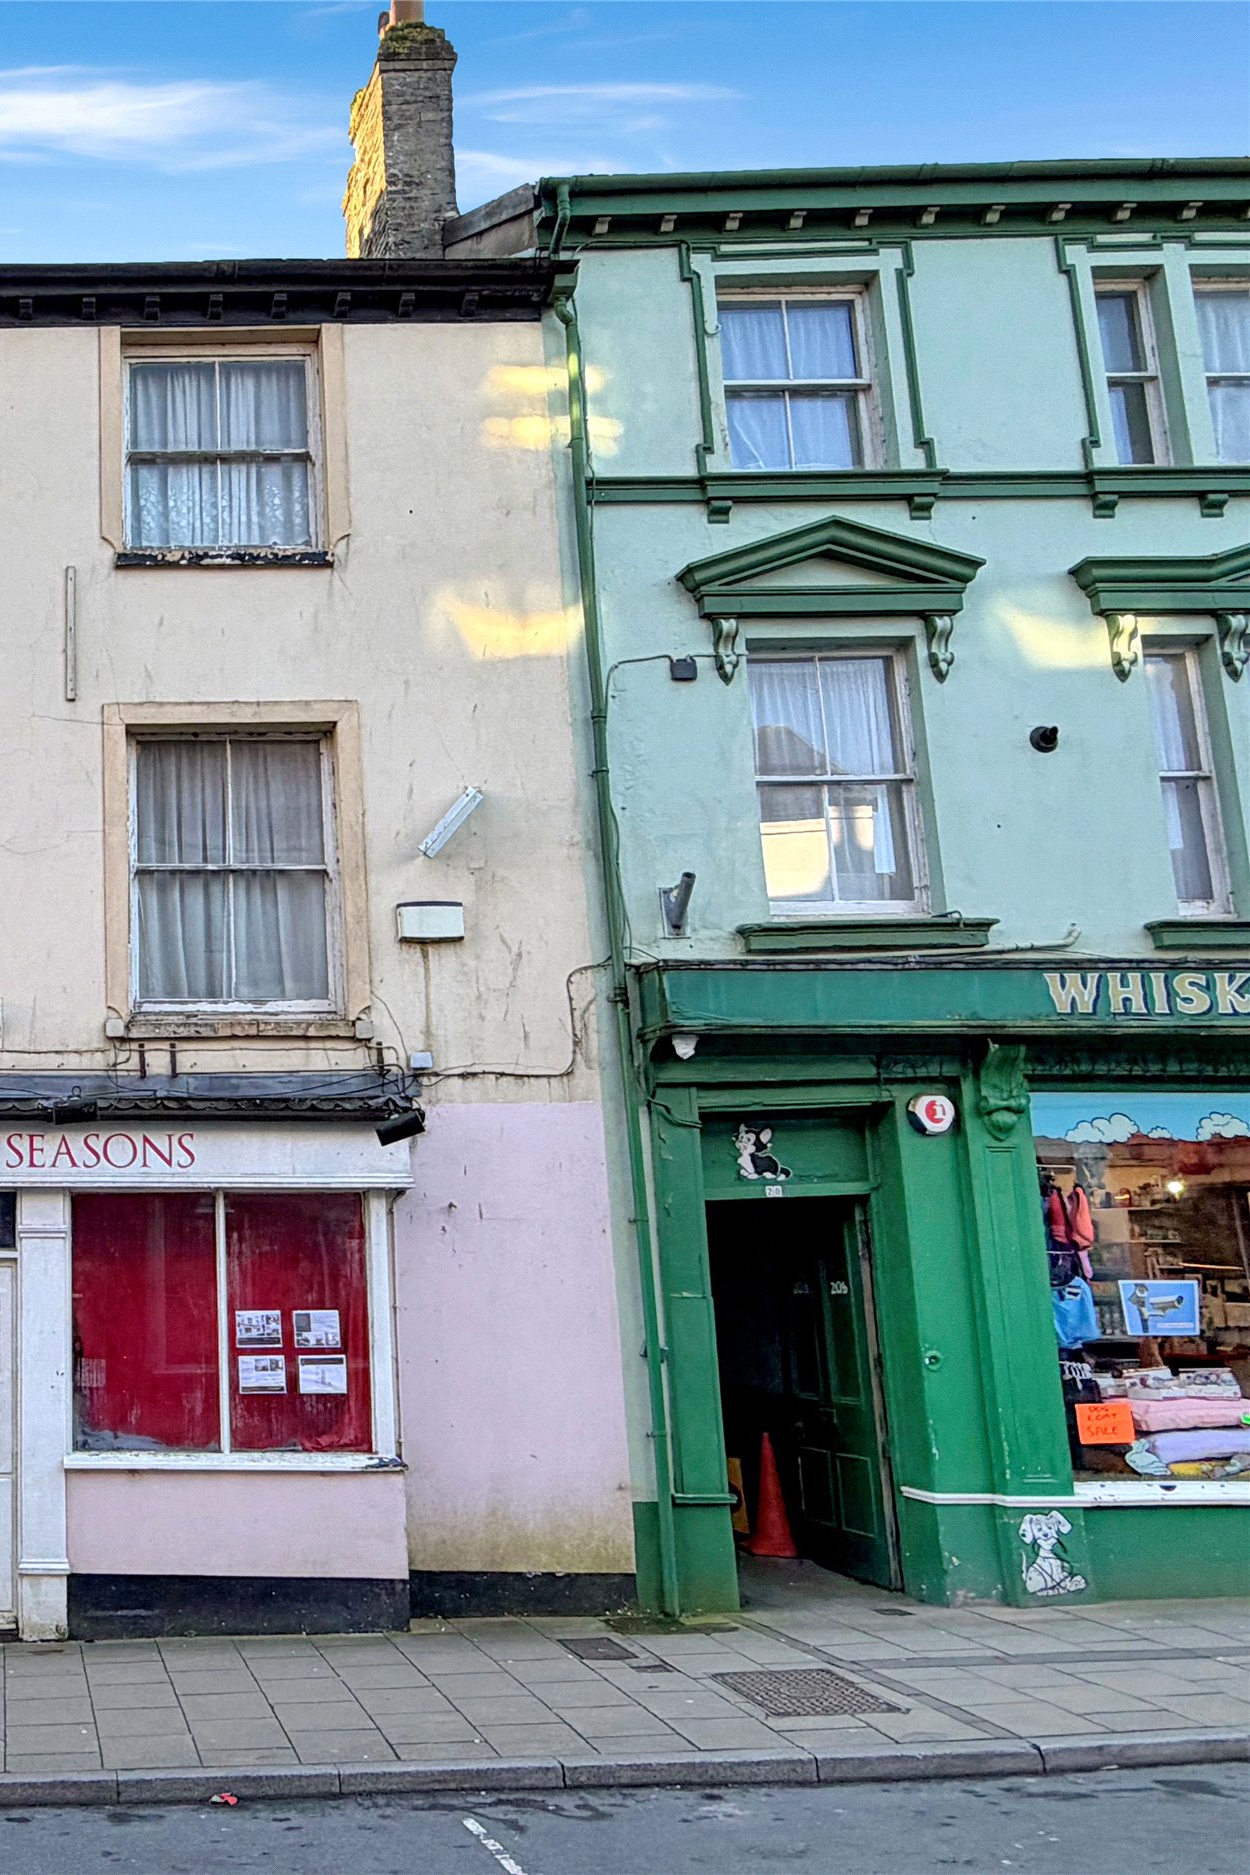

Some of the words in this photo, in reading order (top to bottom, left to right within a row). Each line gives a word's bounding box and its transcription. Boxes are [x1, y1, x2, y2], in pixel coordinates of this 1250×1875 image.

[1043, 973, 1250, 1014] WHISK
[5, 1132, 196, 1169] SEASONS
[1088, 1404, 1109, 1413] DOG
[1087, 1425, 1119, 1436] SALE
